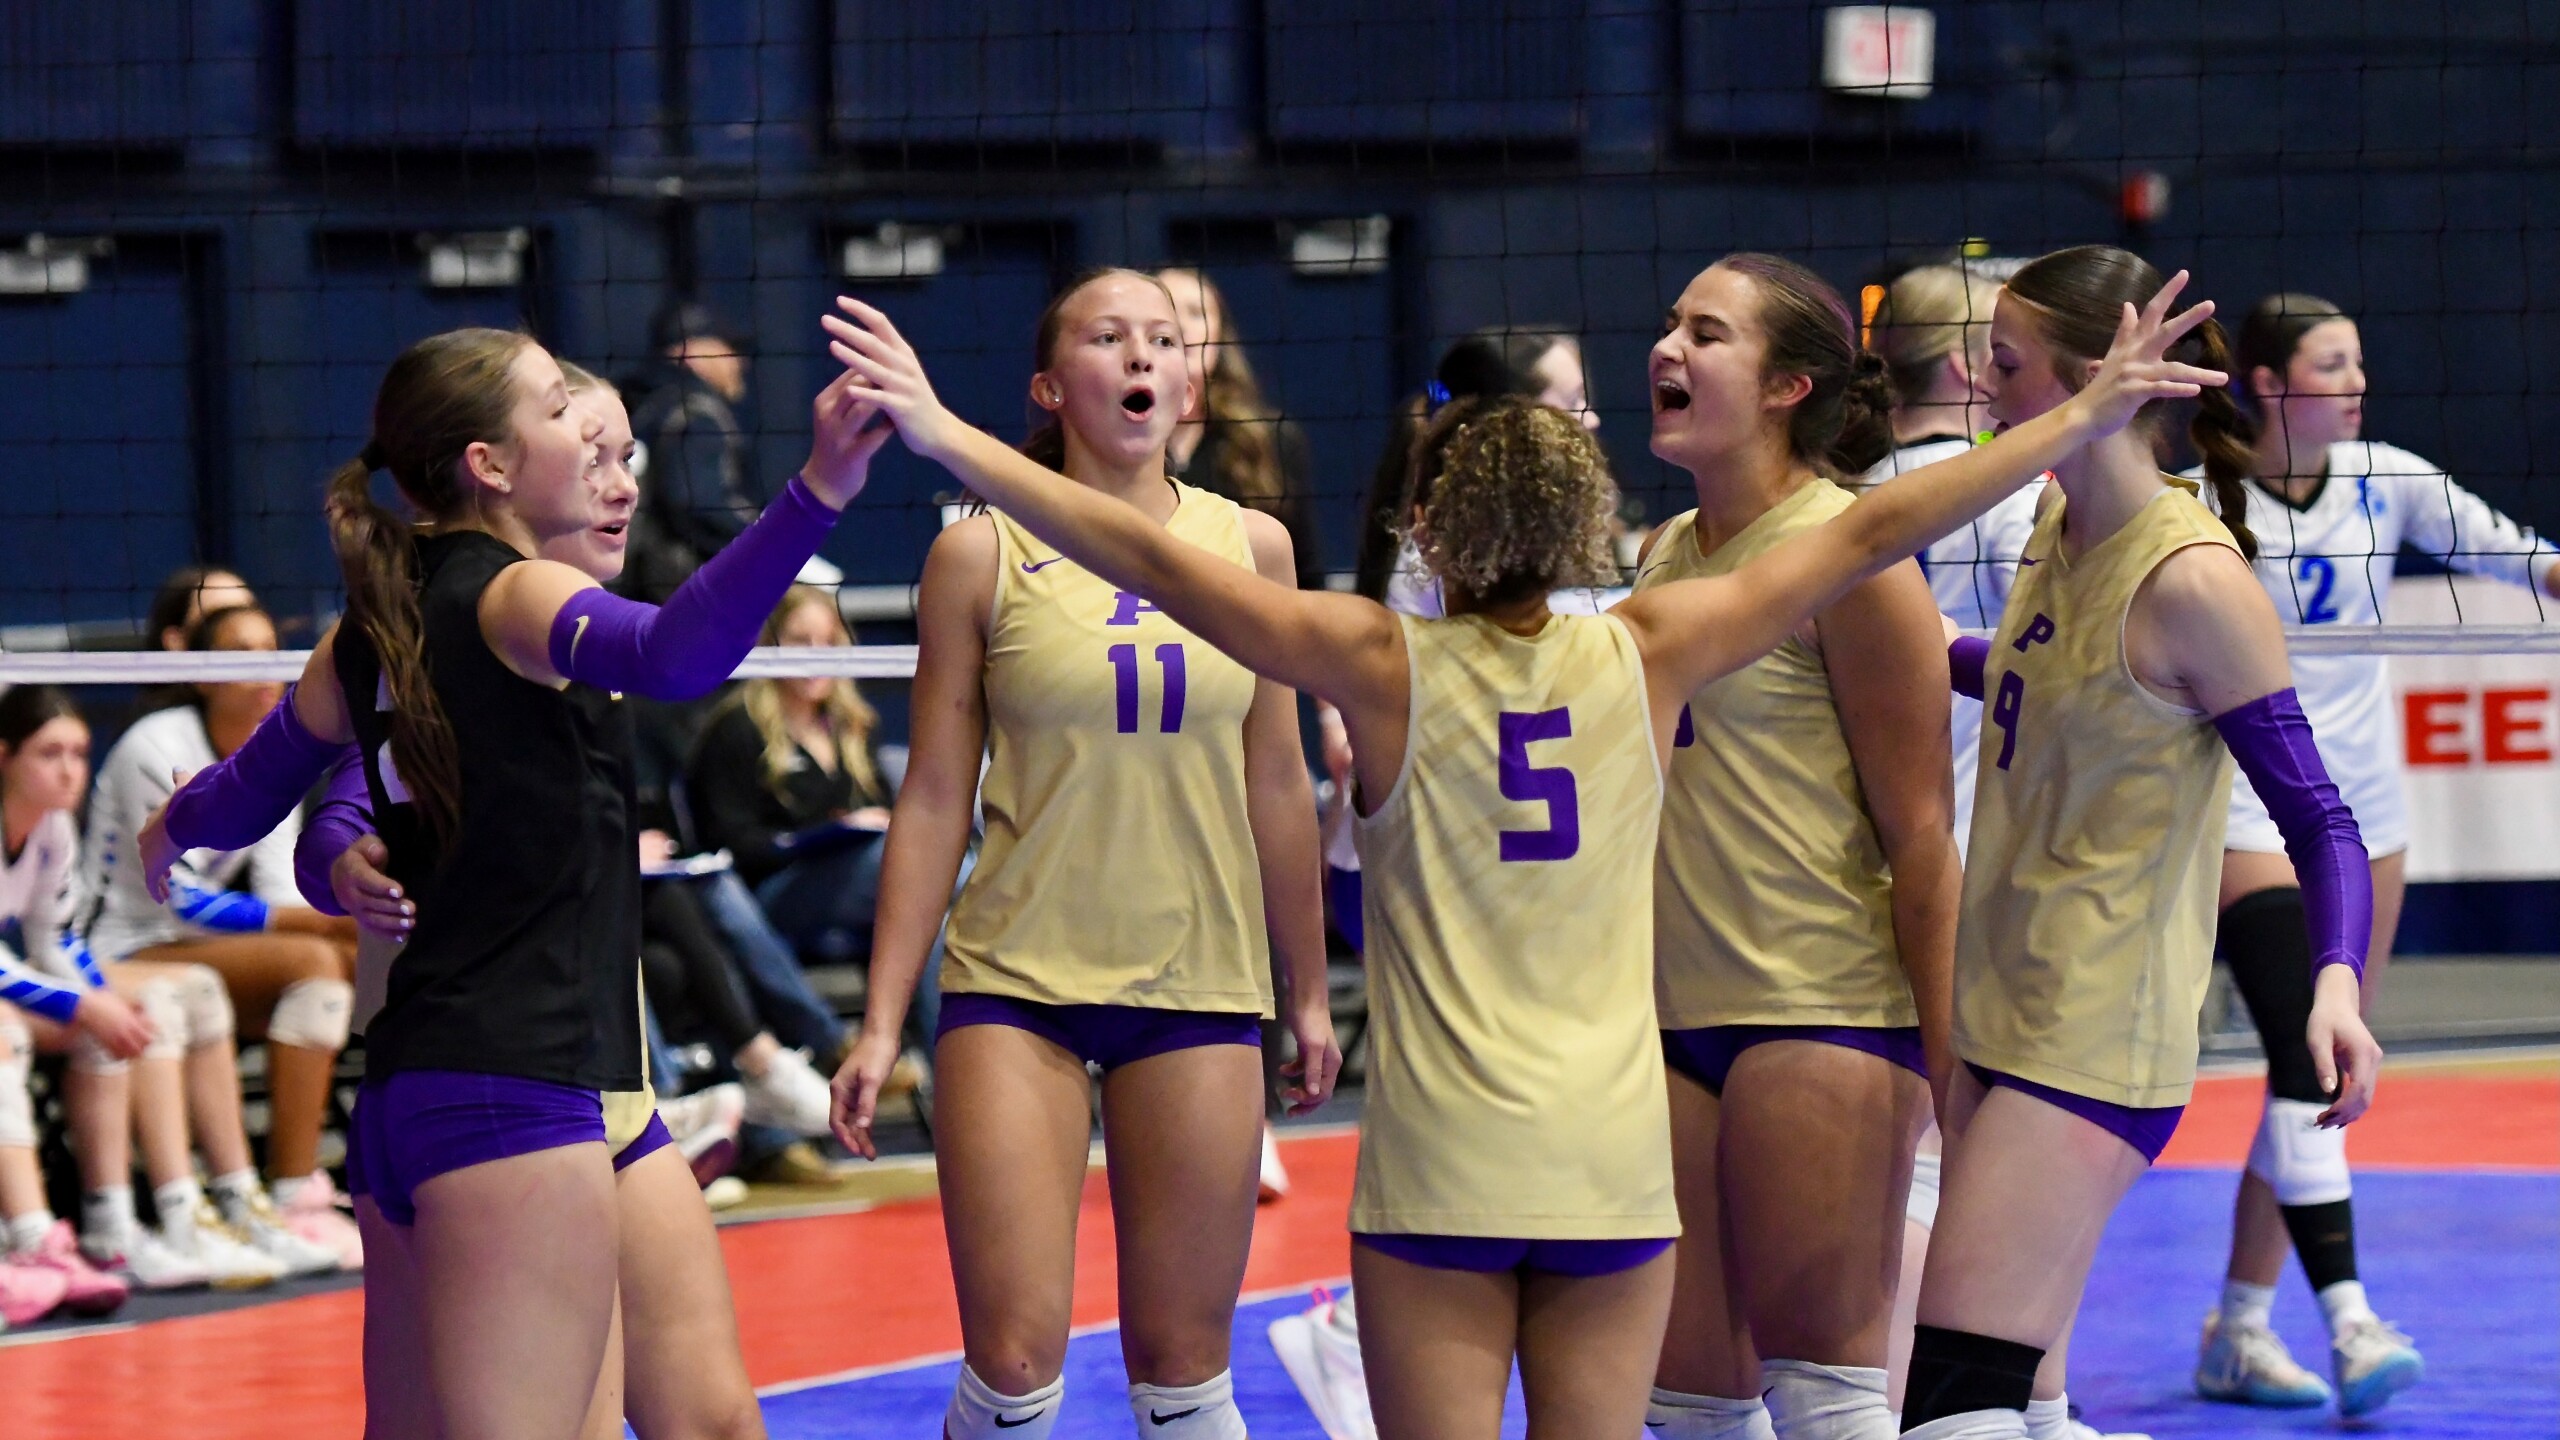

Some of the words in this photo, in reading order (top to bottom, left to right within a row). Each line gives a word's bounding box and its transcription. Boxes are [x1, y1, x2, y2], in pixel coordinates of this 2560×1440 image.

[2299, 557, 2336, 623] 2
[2013, 613, 2055, 653] P
[1108, 644, 1186, 733] 11
[1993, 670, 2024, 771] 9
[2404, 689, 2552, 765] EE
[1499, 706, 1580, 862] 5
